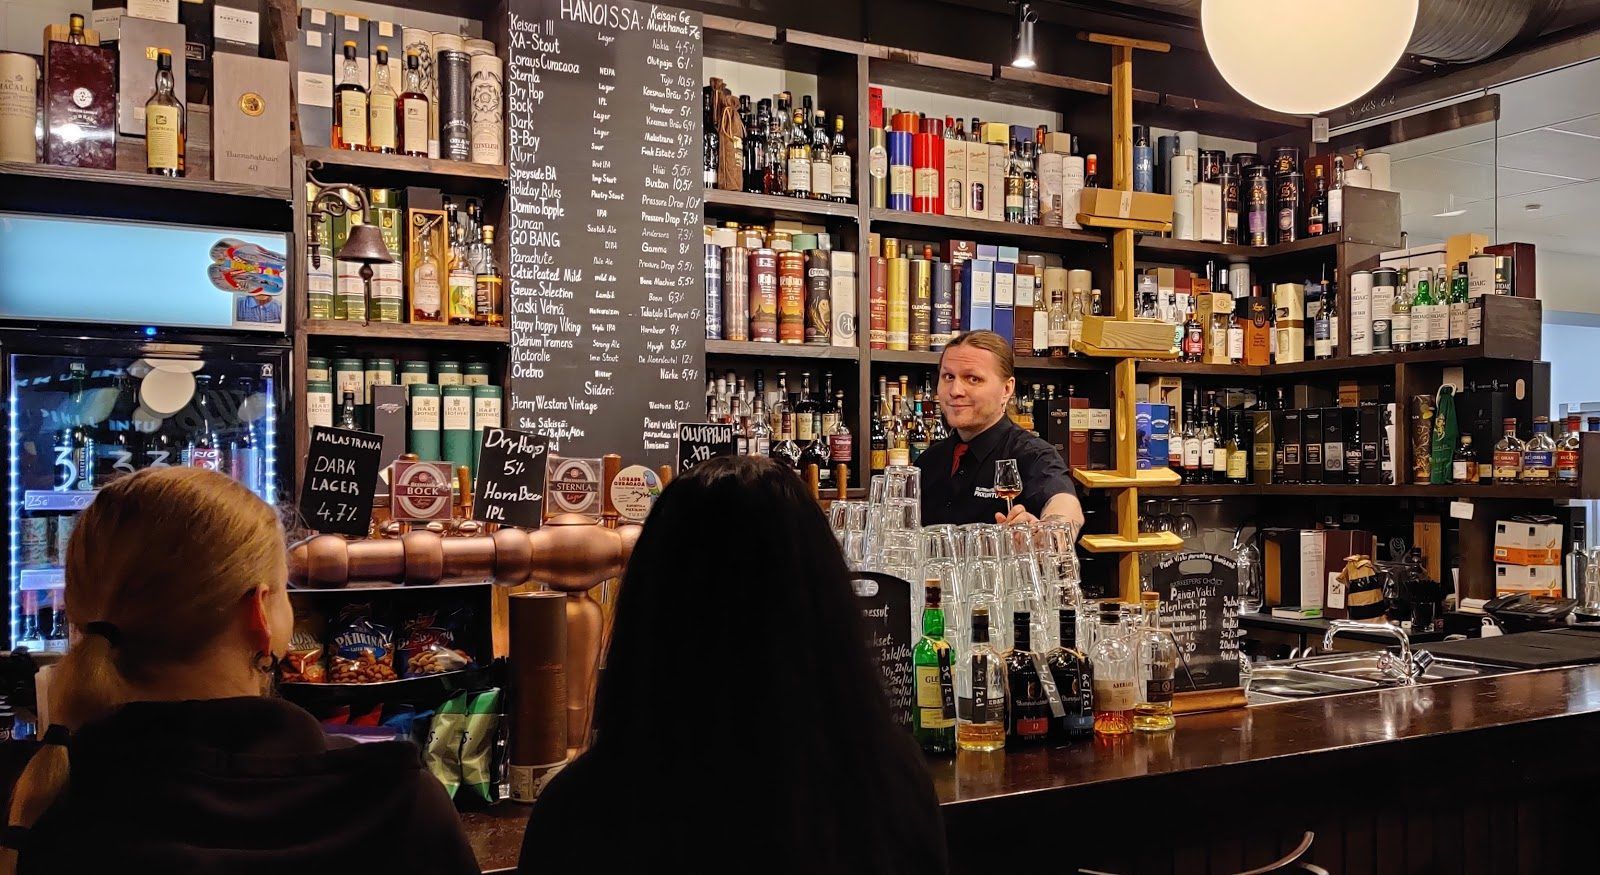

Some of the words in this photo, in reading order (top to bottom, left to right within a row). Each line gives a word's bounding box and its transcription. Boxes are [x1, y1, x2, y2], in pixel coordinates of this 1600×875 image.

[560, 0, 644, 31] HANOISSA:
[650, 5, 677, 21] Keisari
[678, 10, 690, 24] 6€
[510, 14, 540, 34] Keisari
[598, 32, 614, 46] Lager
[652, 38, 670, 51] Nokia
[688, 25, 700, 40] 7€
[510, 31, 560, 54] XA-Stout
[510, 48, 540, 68] Loraus
[509, 82, 526, 100] Dry
[528, 83, 544, 104] Hop
[598, 82, 615, 96] Lager
[510, 99, 533, 114] Bock
[594, 110, 610, 122] Lager
[510, 112, 534, 130] Dark
[594, 128, 610, 140] Lager
[510, 129, 540, 151] B-Boy
[591, 142, 604, 150] Sour
[510, 146, 536, 164] Nuri
[510, 163, 544, 180] Speyside
[544, 166, 556, 180] BA
[510, 180, 539, 198] Holiday
[510, 198, 540, 216] Domino
[540, 197, 564, 220] Topple
[510, 214, 544, 231] Duncan
[511, 231, 528, 246] GO
[530, 231, 560, 248] BANG
[510, 247, 554, 265] Parachute
[564, 269, 582, 283] Mild
[511, 281, 538, 298] Geuze
[538, 282, 574, 300] Selection
[511, 297, 538, 314] Kaski
[511, 315, 534, 336] Happy
[535, 316, 558, 336] hoppy
[560, 316, 582, 336] Viking
[512, 333, 543, 349] Delirium
[543, 334, 573, 349] Tremens
[512, 396, 536, 413] Henry
[536, 396, 568, 411] Westons
[568, 397, 598, 414] Vintage
[644, 418, 661, 430] Pieni
[662, 418, 678, 430] viski
[316, 432, 381, 450] MALASTRANA
[682, 426, 731, 445] OLUTPAJA
[692, 446, 717, 462] XA-
[314, 456, 356, 476] DARK
[504, 460, 526, 476] 5%
[312, 478, 360, 496] LAGER
[407, 486, 438, 496] BOCK
[556, 482, 592, 492] STERNLA
[316, 502, 358, 522] 4,7%
[486, 504, 506, 521] IPL
[1199, 598, 1208, 608] 12
[1199, 610, 1208, 620] 12
[1199, 620, 1208, 630] 18
[1186, 643, 1196, 652] 30
[1184, 653, 1191, 662] 10
